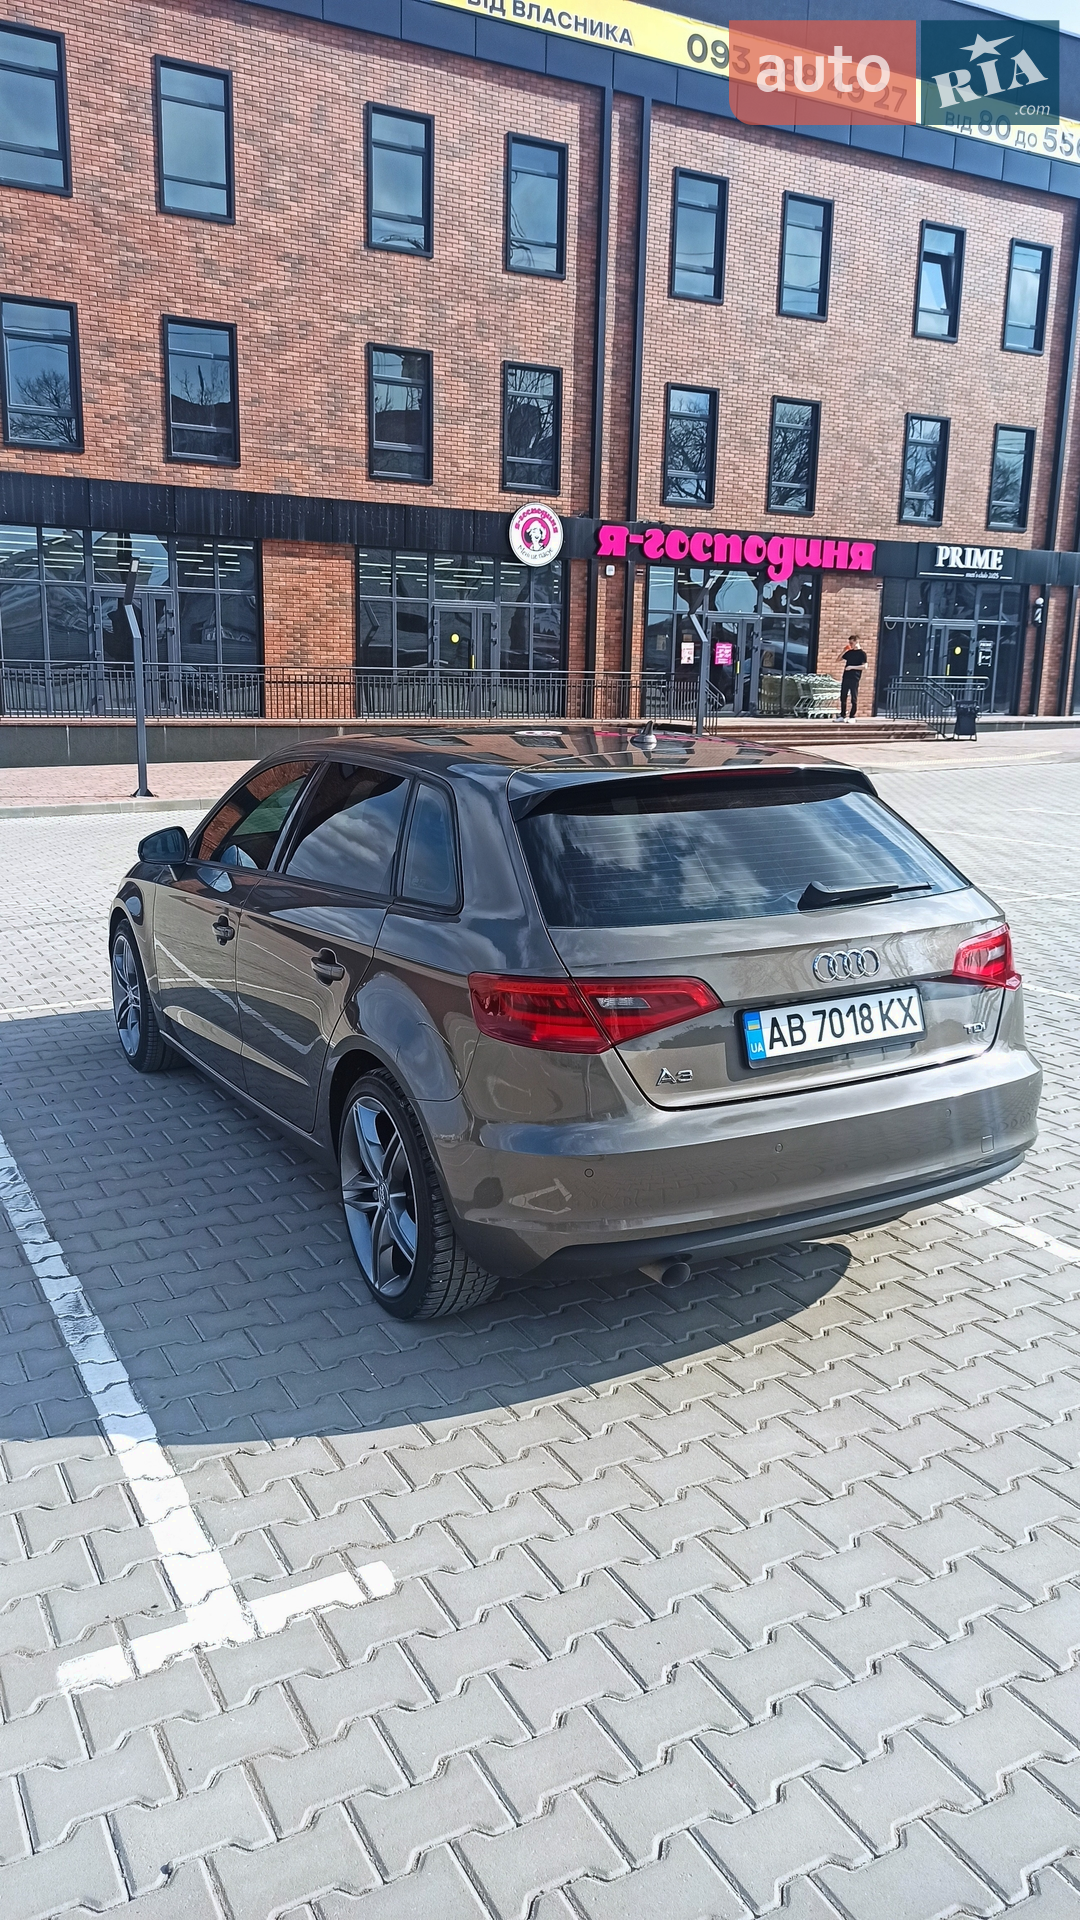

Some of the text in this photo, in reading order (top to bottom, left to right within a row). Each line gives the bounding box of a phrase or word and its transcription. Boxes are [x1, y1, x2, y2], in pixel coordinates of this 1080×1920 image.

[512, 0, 633, 46] ВЛАСНИКА
[687, 33, 750, 75] 093
[874, 82, 908, 113] 27
[977, 109, 1011, 141] 80
[1042, 127, 1080, 159] 55
[934, 545, 1003, 570] PRIME
[769, 995, 918, 1050] AB 7018 KX
[963, 1021, 986, 1034] TDI
[750, 1041, 764, 1053] UA
[655, 1067, 694, 1086] A3
